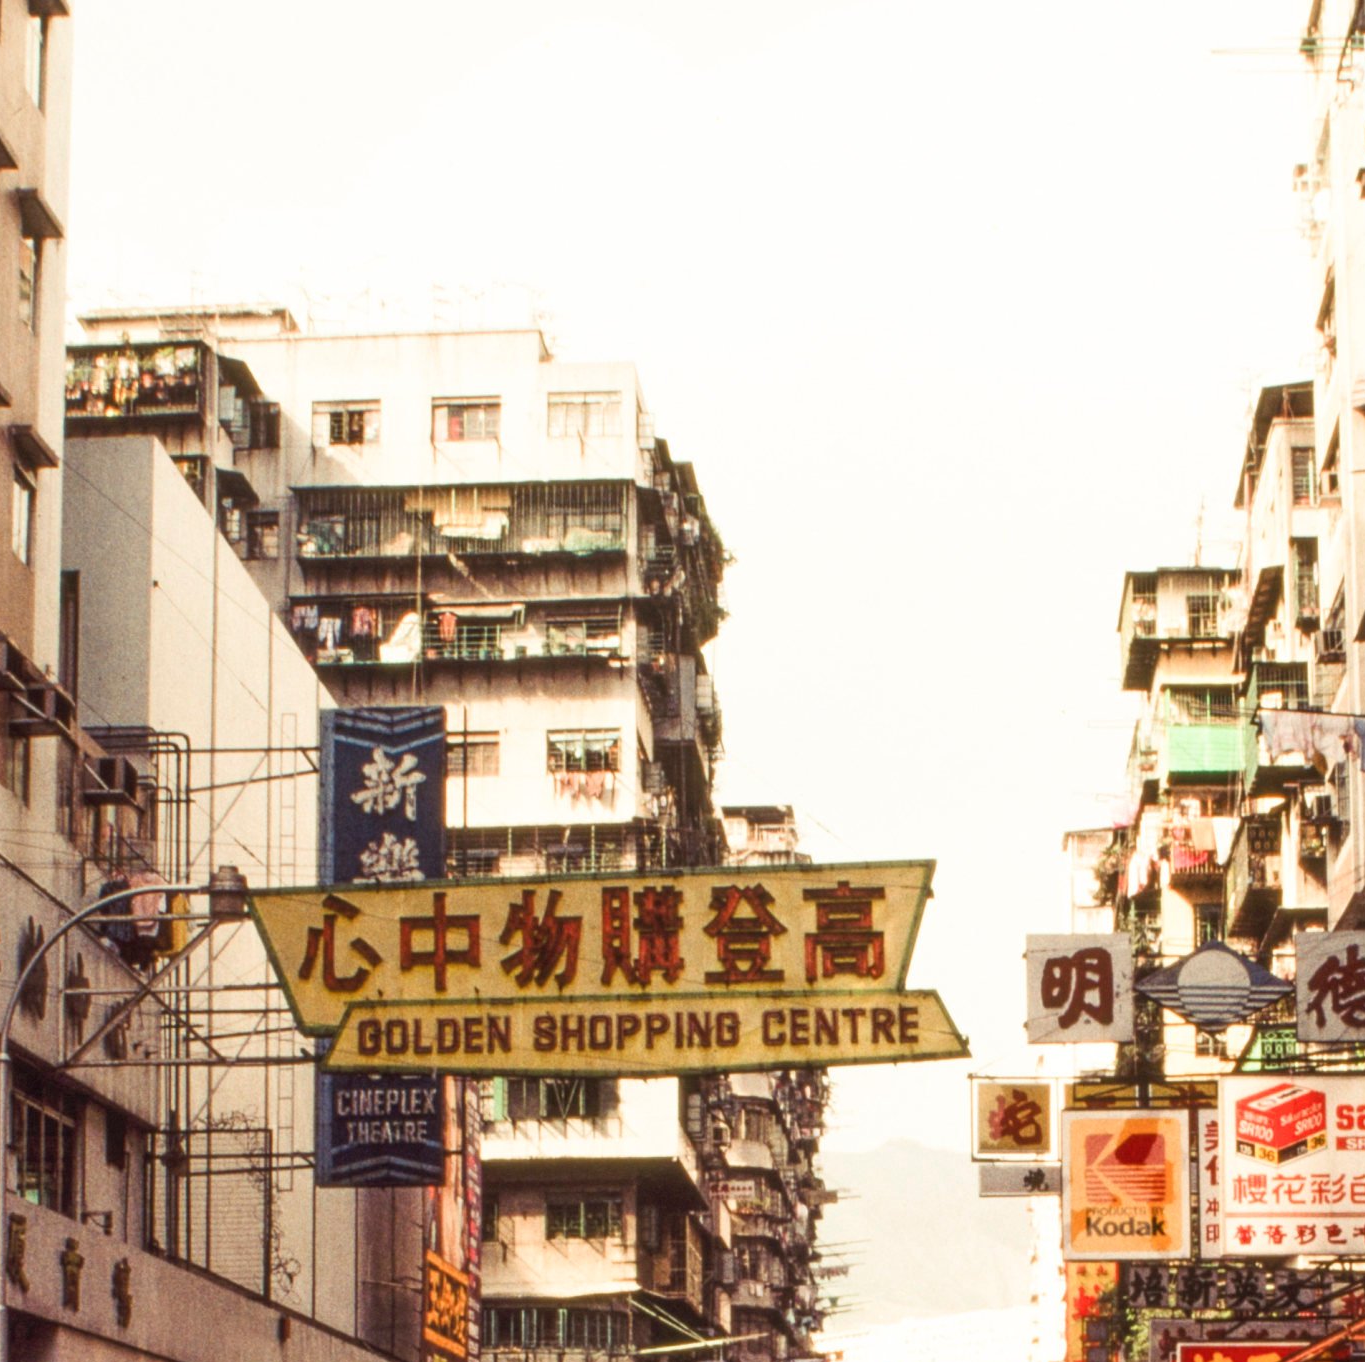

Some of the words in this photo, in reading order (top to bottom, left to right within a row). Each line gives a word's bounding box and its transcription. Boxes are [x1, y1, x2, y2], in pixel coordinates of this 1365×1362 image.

[1040, 946, 1114, 1030] 明
[355, 1013, 513, 1057] GOLDEN
[533, 1010, 740, 1053] SHOPPING
[760, 1006, 920, 1046] CENTRE
[336, 1089, 437, 1117] CINEPLEX
[987, 1088, 1044, 1146] 蛇
[345, 1121, 428, 1144] THEATRE
[1257, 1147, 1276, 1163] 36
[1085, 1216, 1166, 1237] Kodak
